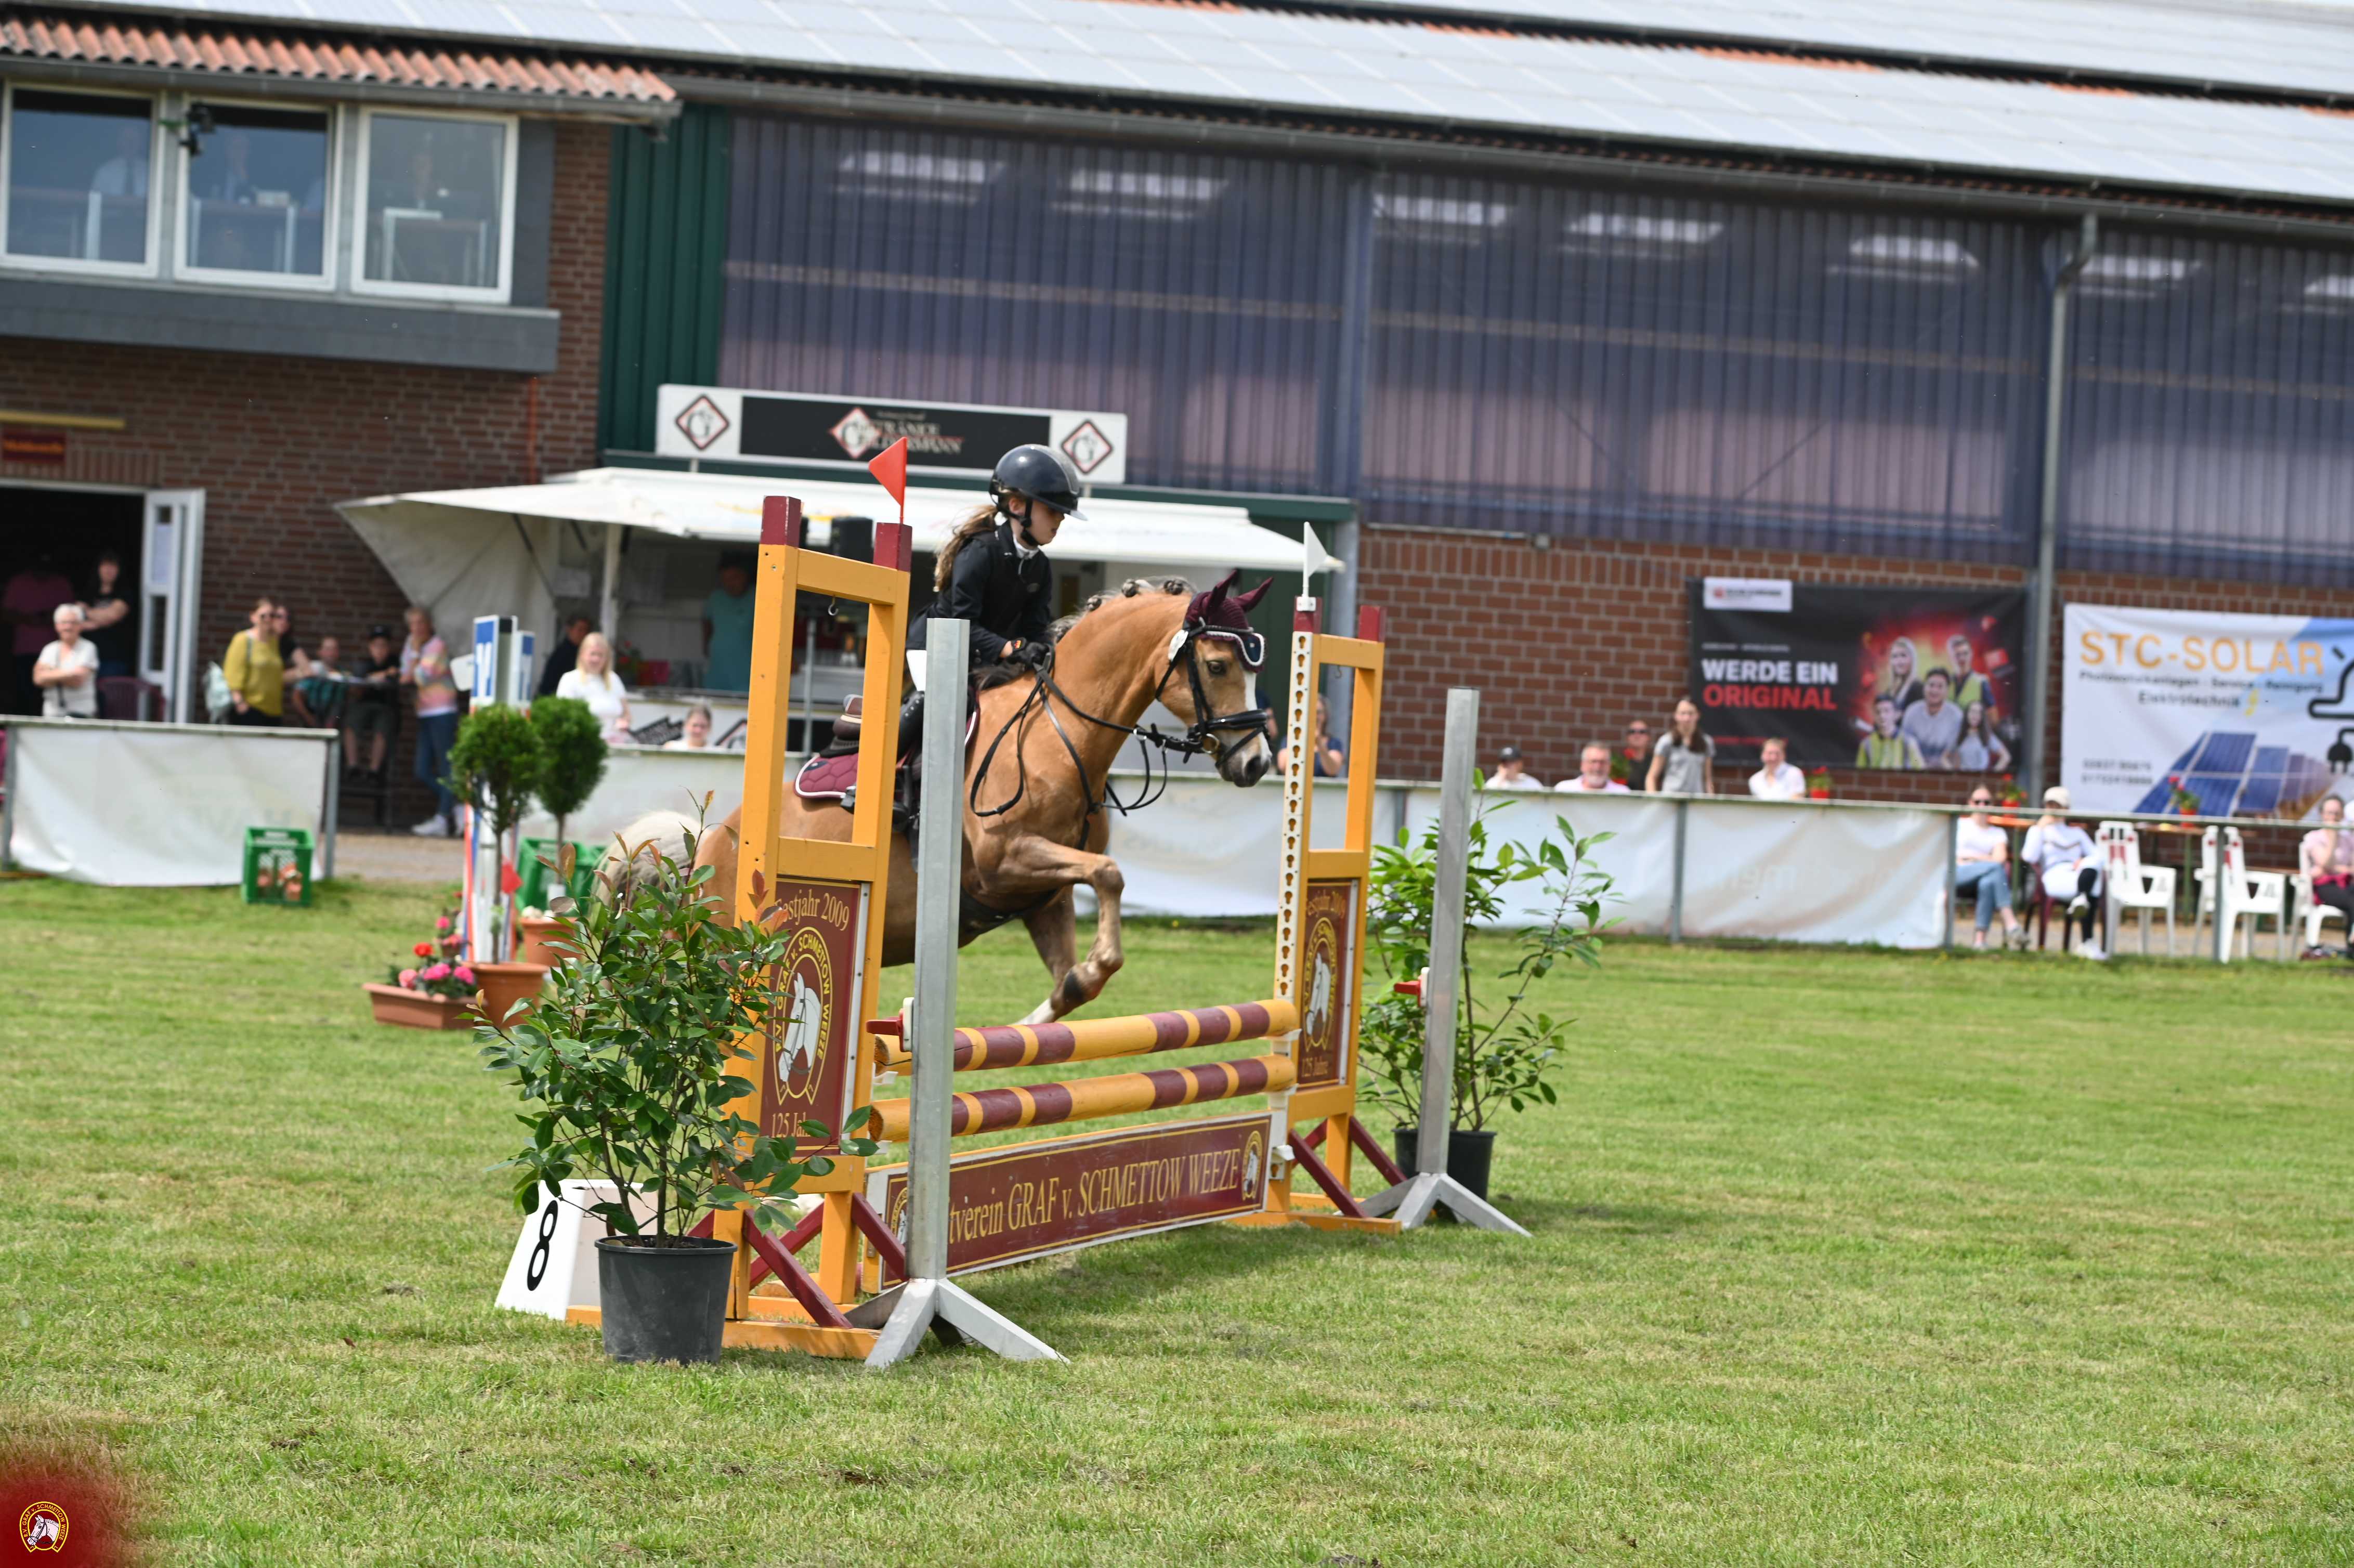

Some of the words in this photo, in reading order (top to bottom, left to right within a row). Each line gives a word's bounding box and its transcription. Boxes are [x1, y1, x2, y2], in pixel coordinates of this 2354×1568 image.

[1701, 658, 1791, 683] WERDE
[1796, 661, 1838, 685] EIN
[2080, 630, 2324, 675] STC-SOLAR
[1703, 683, 1838, 711] ORIGINAL
[775, 888, 820, 925] estjahr
[821, 893, 849, 931] 2009
[799, 934, 830, 995] SCHMETTOW
[817, 1003, 830, 1060] WEEZE
[771, 1113, 790, 1138] 125
[948, 1187, 1004, 1244] tverein
[1008, 1177, 1060, 1230] GRAF
[1062, 1188, 1073, 1220] v.
[1078, 1156, 1186, 1217] SCHMETTOW
[1189, 1148, 1240, 1197] WEEZE
[527, 1200, 558, 1291] 8
